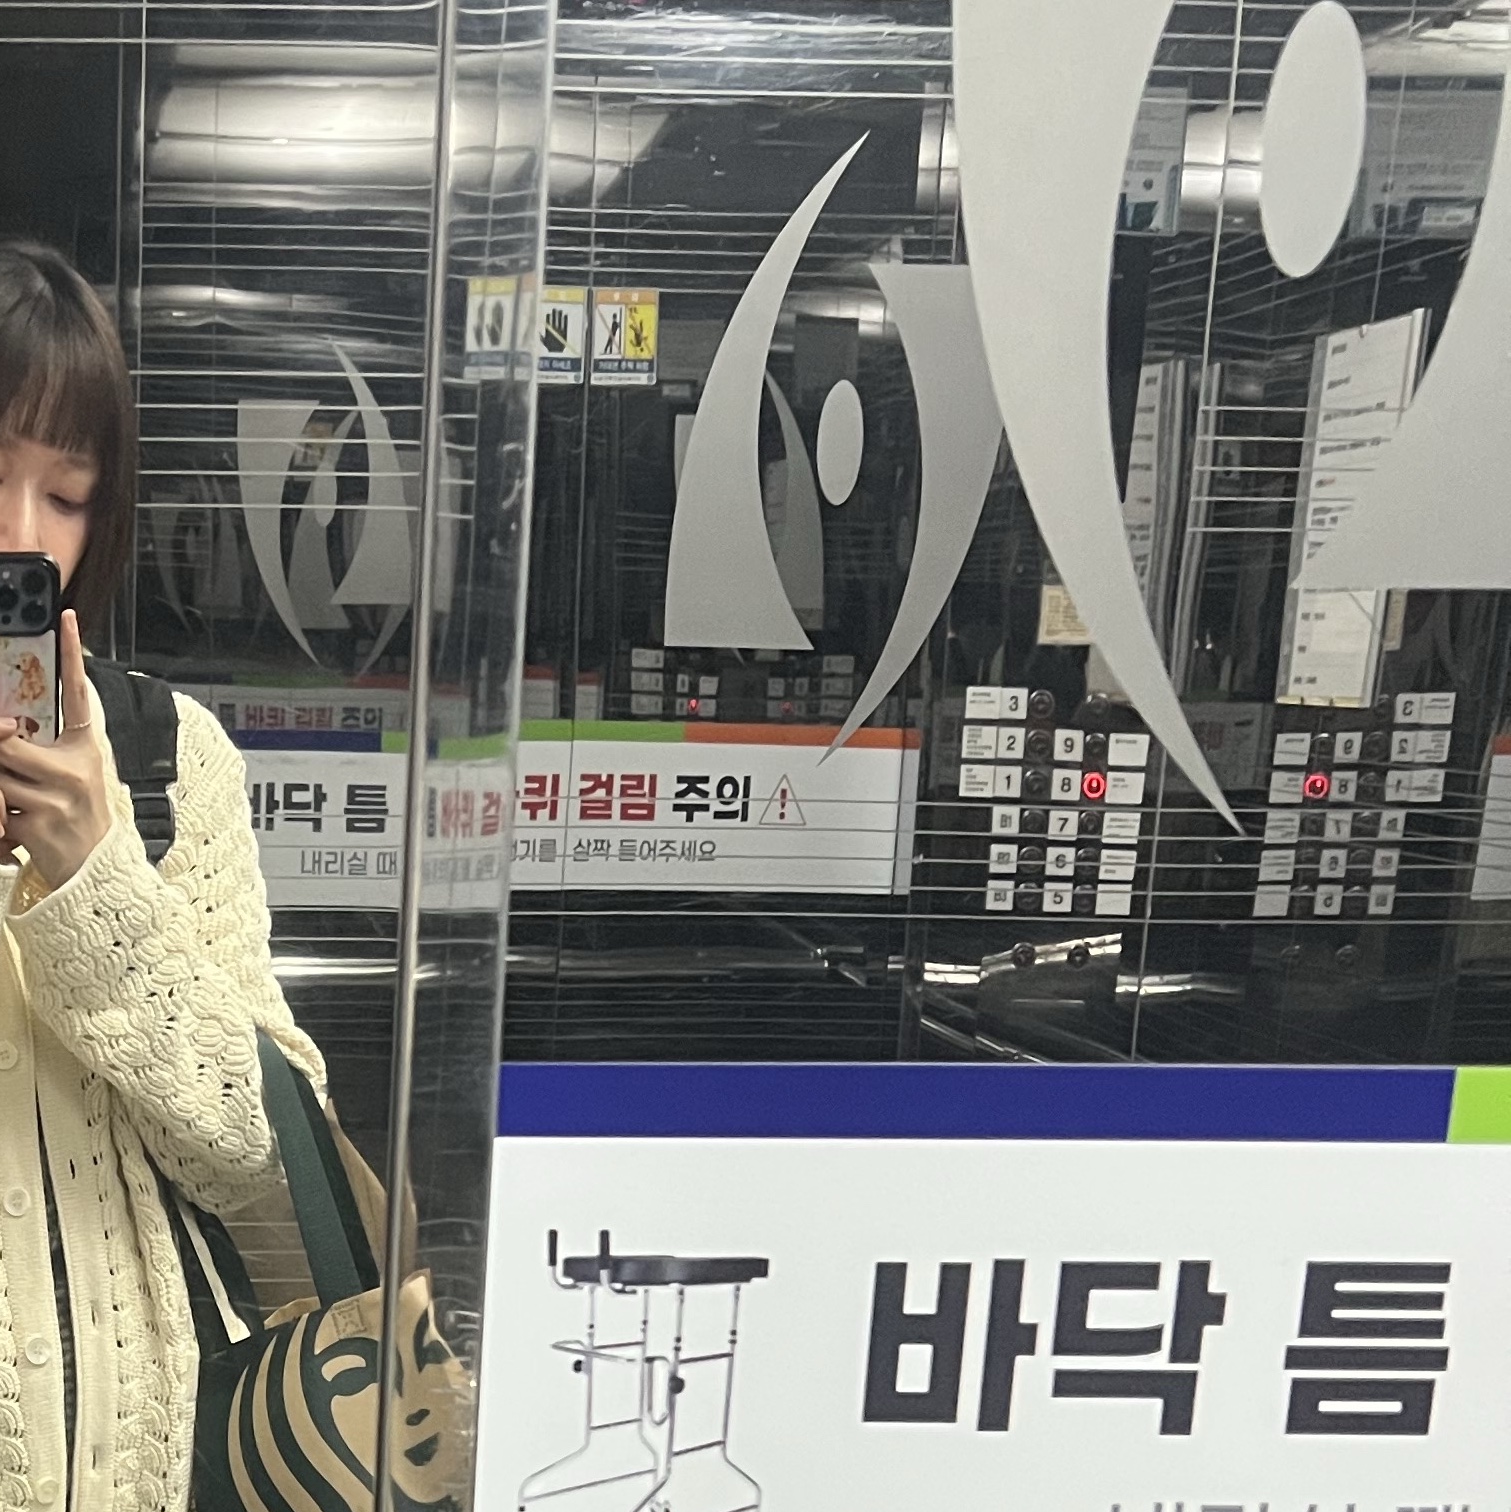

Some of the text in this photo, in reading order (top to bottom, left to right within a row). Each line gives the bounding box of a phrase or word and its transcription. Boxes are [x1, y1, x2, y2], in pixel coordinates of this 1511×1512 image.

[1009, 696, 1019, 711] 3
[1007, 736, 1017, 751] 2
[1064, 737, 1074, 753] 9
[1061, 777, 1072, 793] 8
[515, 773, 752, 823] 퀴 걸림 주의
[343, 785, 389, 833] 틈
[1058, 818, 1069, 832] 7
[617, 839, 717, 863] 들어주세요
[300, 850, 369, 876] 내리실
[376, 850, 398, 876] 때
[1055, 853, 1066, 869] 6
[1054, 888, 1064, 905] 5
[862, 1258, 1452, 1436] 바닥 틈
